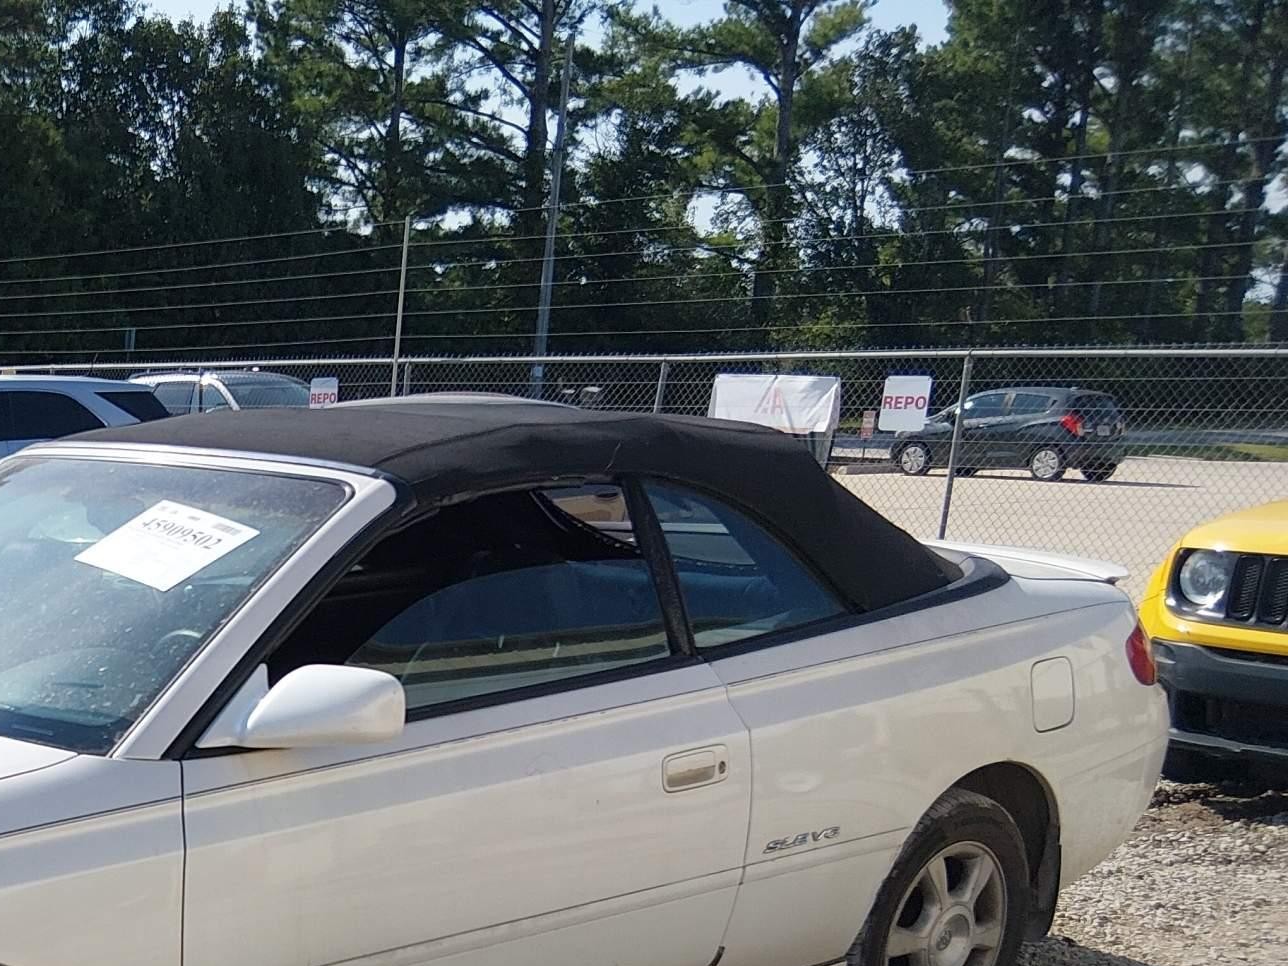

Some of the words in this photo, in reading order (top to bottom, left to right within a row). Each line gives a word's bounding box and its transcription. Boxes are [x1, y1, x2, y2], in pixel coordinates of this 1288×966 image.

[311, 392, 337, 404] REPO
[882, 395, 927, 410] REPO
[142, 518, 222, 549] 45909502
